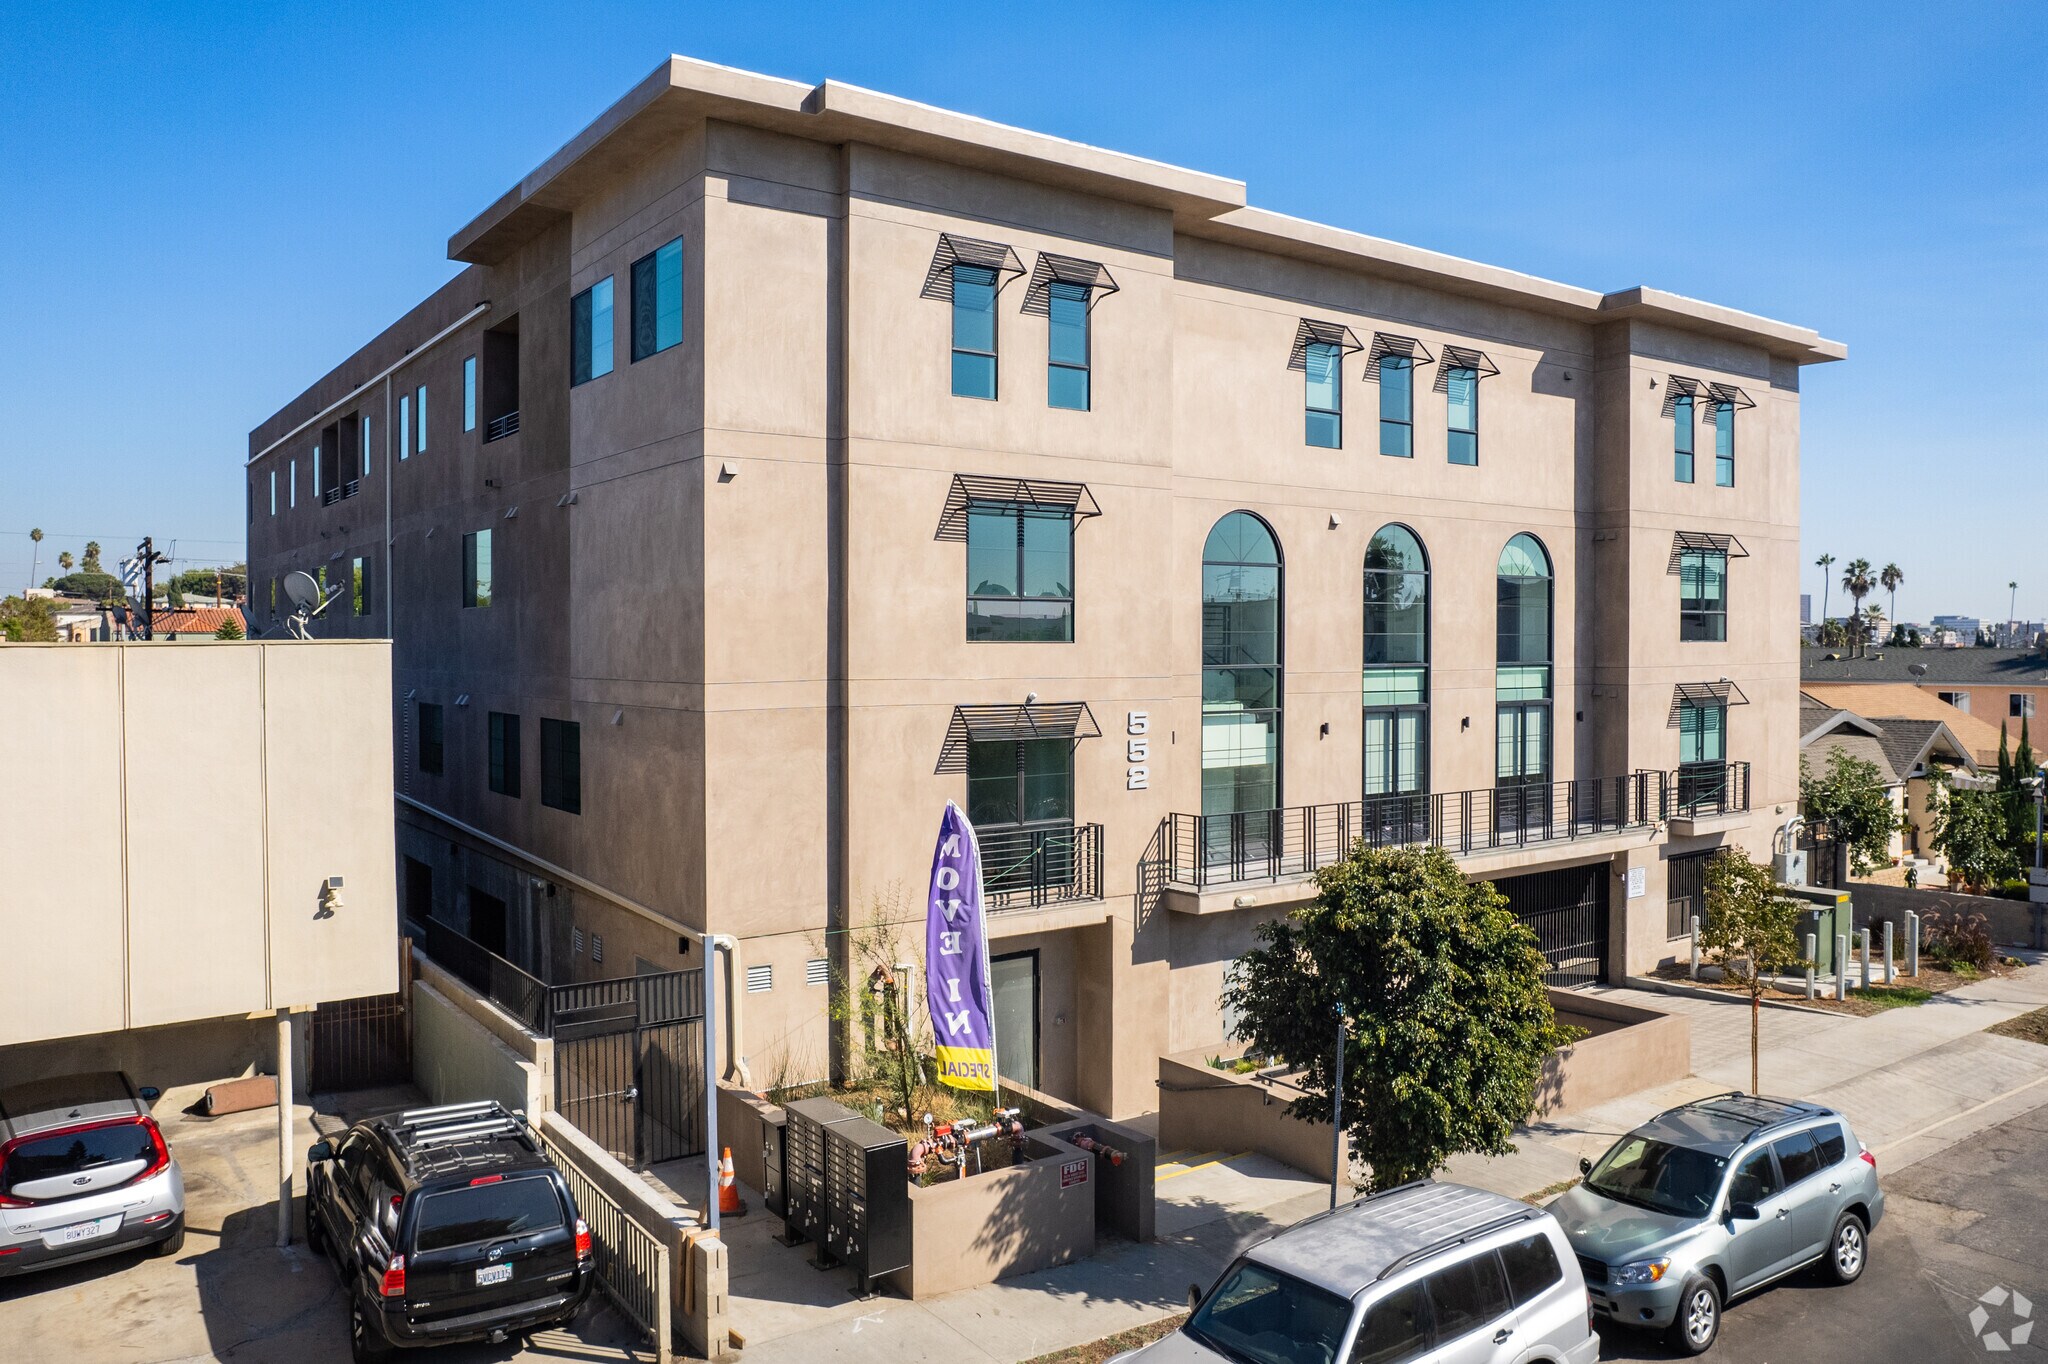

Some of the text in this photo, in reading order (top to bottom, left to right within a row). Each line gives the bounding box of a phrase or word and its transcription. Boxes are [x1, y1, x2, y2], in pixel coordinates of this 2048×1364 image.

[1127, 711, 1150, 791] 552
[1063, 1161, 1085, 1175] FDC
[66, 1224, 100, 1240] 8UWY327
